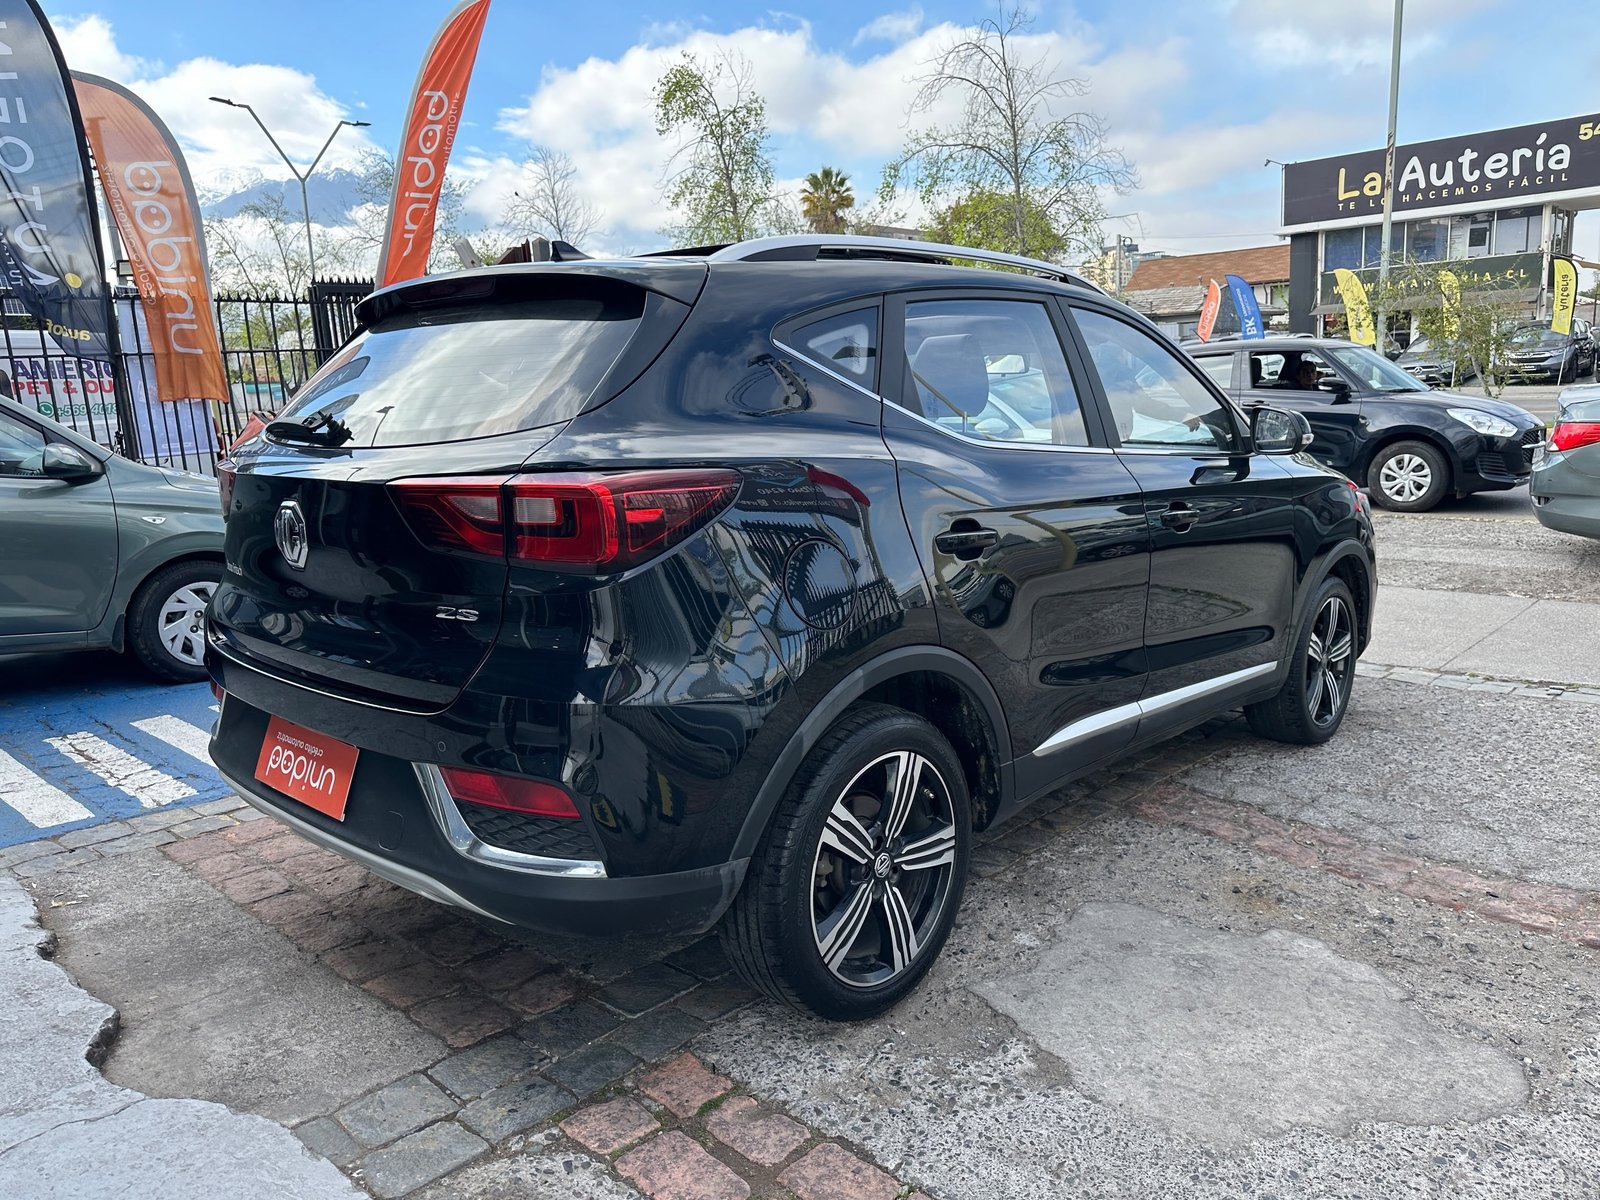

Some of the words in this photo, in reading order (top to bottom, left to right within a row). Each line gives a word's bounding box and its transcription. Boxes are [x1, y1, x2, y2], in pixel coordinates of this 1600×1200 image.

[1337, 167, 1382, 201] La
[1398, 132, 1571, 192] Autería
[1337, 201, 1356, 211] TE
[1402, 182, 1492, 203] HACEMOS
[1508, 172, 1568, 189] FÁCIL
[11, 380, 52, 396] PET
[435, 605, 480, 622] ZS
[265, 745, 336, 796] unidad
